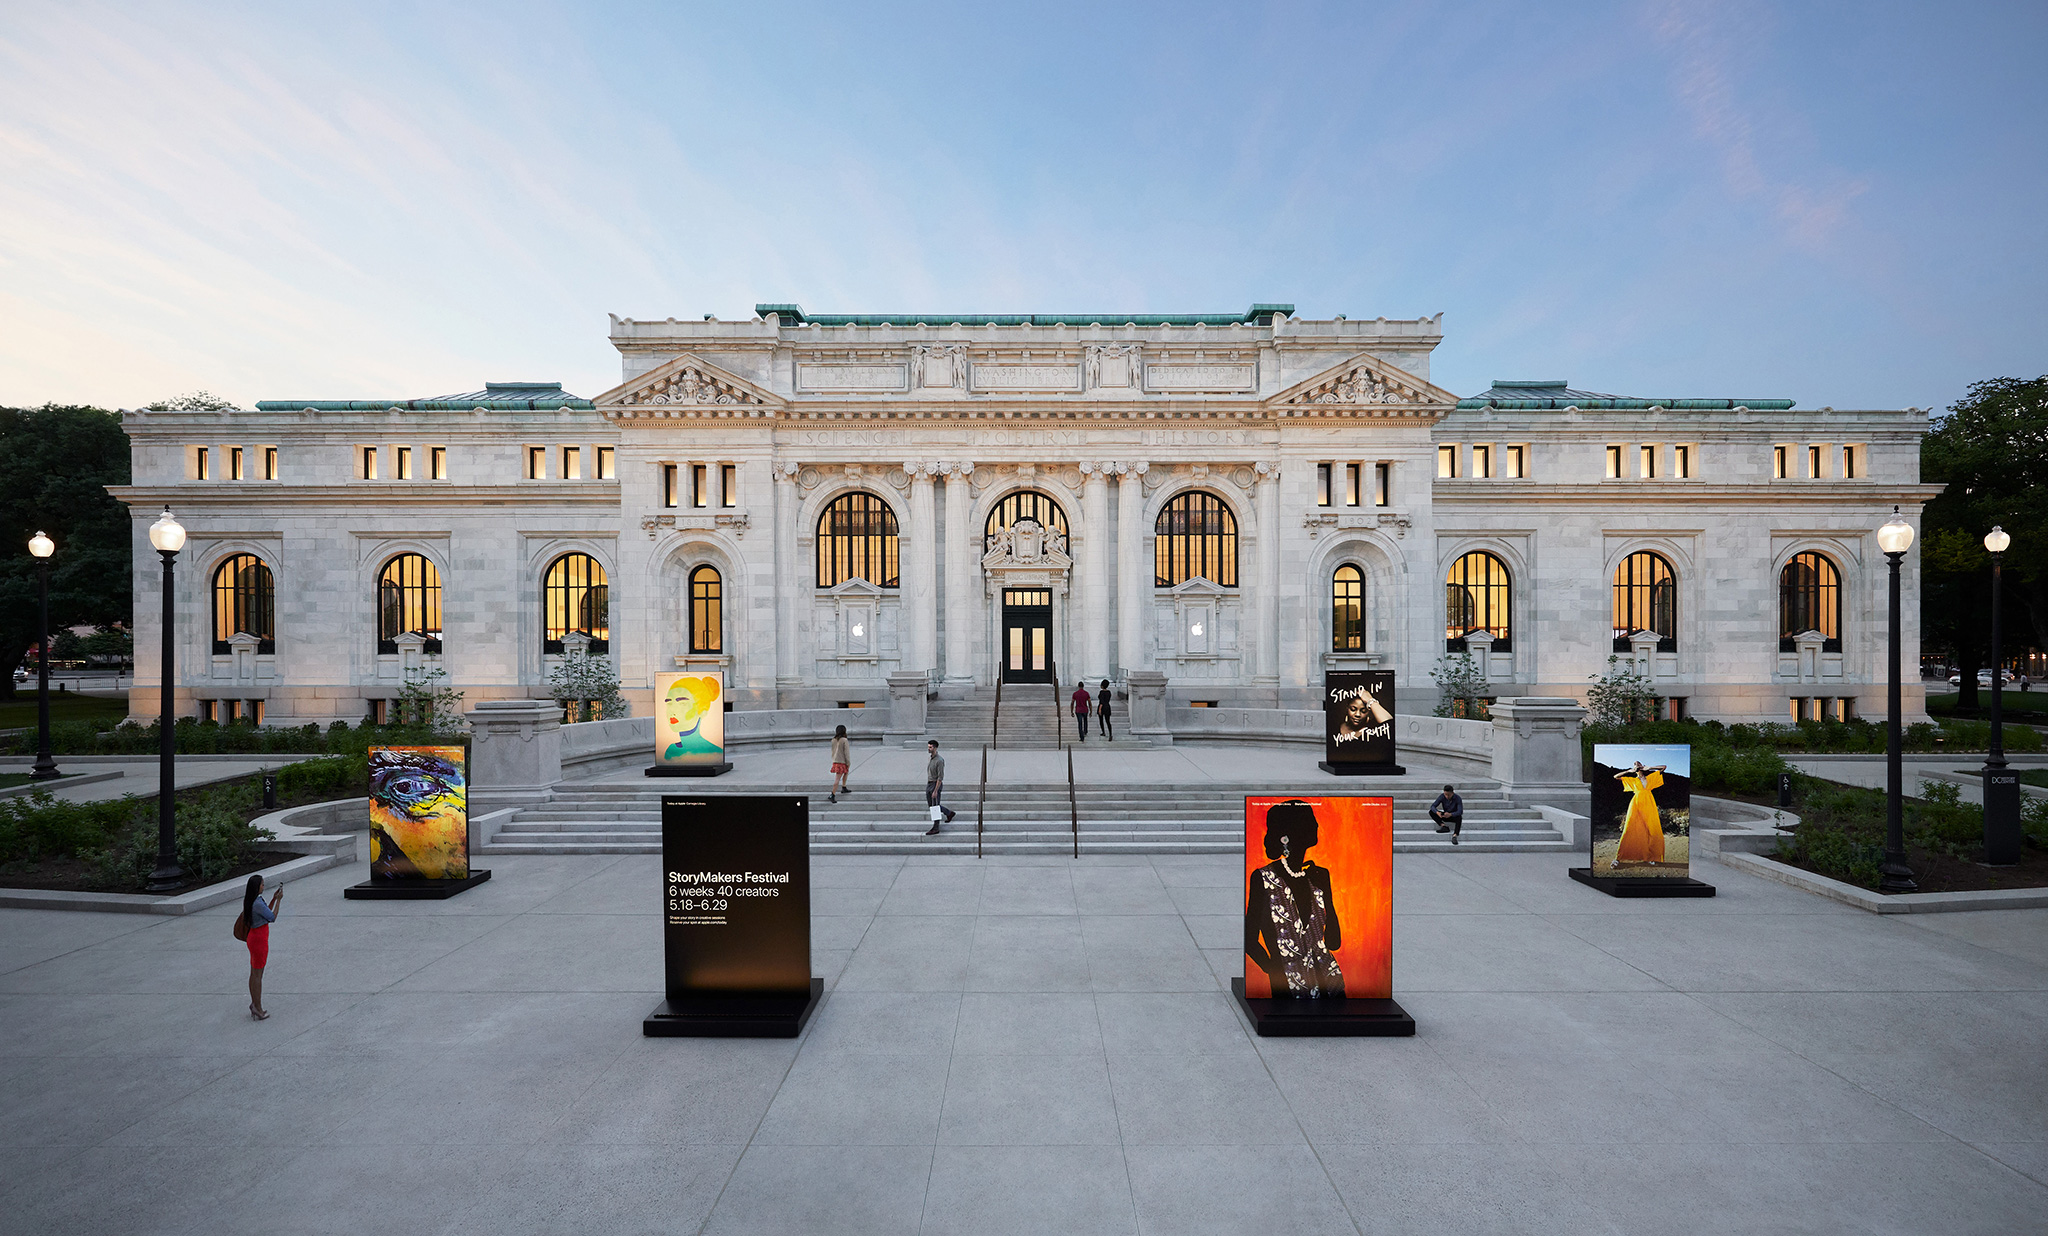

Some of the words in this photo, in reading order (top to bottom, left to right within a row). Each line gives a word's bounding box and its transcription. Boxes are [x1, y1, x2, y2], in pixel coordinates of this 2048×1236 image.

[981, 368, 1070, 376] WASHINGTON
[1024, 377, 1075, 385] LIBRARY
[805, 431, 899, 444] SCIENCE
[981, 431, 1073, 444] POETRY
[1155, 431, 1248, 444] HISTORY
[681, 518, 707, 526] 1899
[1344, 517, 1372, 525] 1902
[1330, 685, 1365, 703] STAND
[1370, 681, 1383, 694] IN
[1192, 711, 1253, 728] FOR
[1332, 731, 1359, 747] YOUR
[1359, 723, 1391, 742] TRUTH
[1991, 776, 2001, 784] DC
[669, 871, 743, 885] StoryMakers
[745, 871, 789, 883] Festival
[669, 885, 678, 897] 6
[679, 885, 715, 897] weeks
[717, 885, 733, 897] 40
[735, 887, 779, 897] creators
